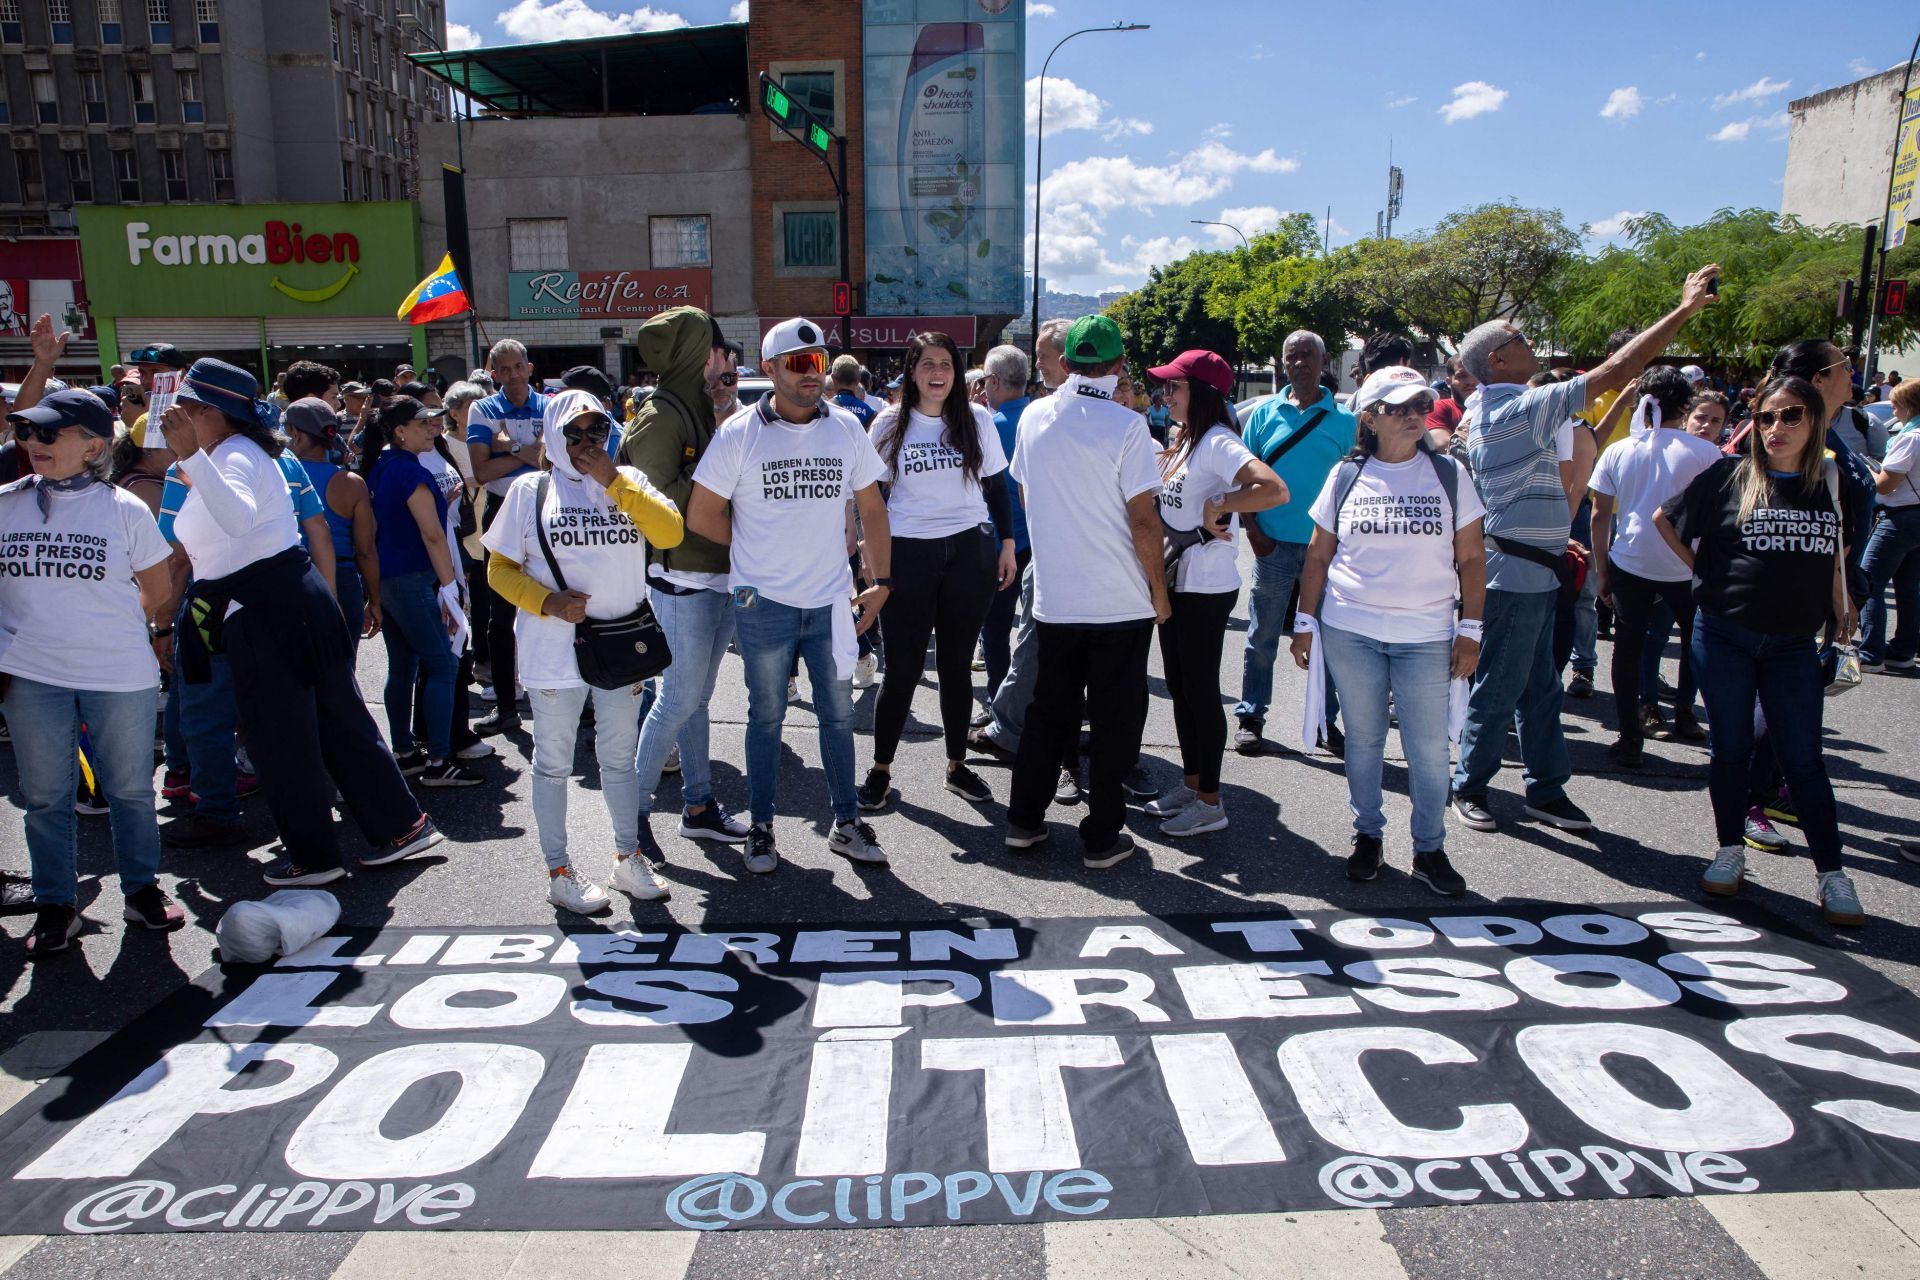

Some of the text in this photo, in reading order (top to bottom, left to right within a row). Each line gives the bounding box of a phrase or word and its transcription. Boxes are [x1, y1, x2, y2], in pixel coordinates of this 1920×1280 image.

[921, 99, 974, 110] shoulders
[1891, 188, 1912, 205] DAKA
[126, 220, 360, 266] FarmaBien
[520, 306, 539, 314] Bar
[542, 305, 601, 314] Restaurant
[902, 442, 938, 451] LIBEREN
[904, 448, 962, 461] LOS PRES
[762, 457, 843, 472] LIBEREN A TODOS
[904, 457, 963, 476] POLÍTIC
[762, 468, 843, 486] LOS PRESOS
[763, 481, 842, 500] POLÍTICOS
[1353, 496, 1441, 506] LIBEREN A TODOS
[551, 506, 591, 515] LIBEREN
[1352, 506, 1442, 519] LOS PRESOS
[1814, 510, 1836, 524] LOS
[550, 513, 635, 528] LOS PRESOS
[1350, 518, 1443, 536] POLÍTICOS
[550, 527, 639, 548] POLÍTICOS
[1741, 521, 1837, 538] CENTROS DE
[2, 532, 108, 548] LIBEREN A TODOS
[1741, 535, 1835, 555] TORTURA
[0, 544, 107, 563] LOS PRESOS
[0, 558, 106, 581] POLÍTICOS
[273, 911, 1762, 967] LIBEREN A TODOS
[202, 951, 1849, 1029] LOS PRESOS
[13, 1014, 1920, 1180] POLÍTICOS
